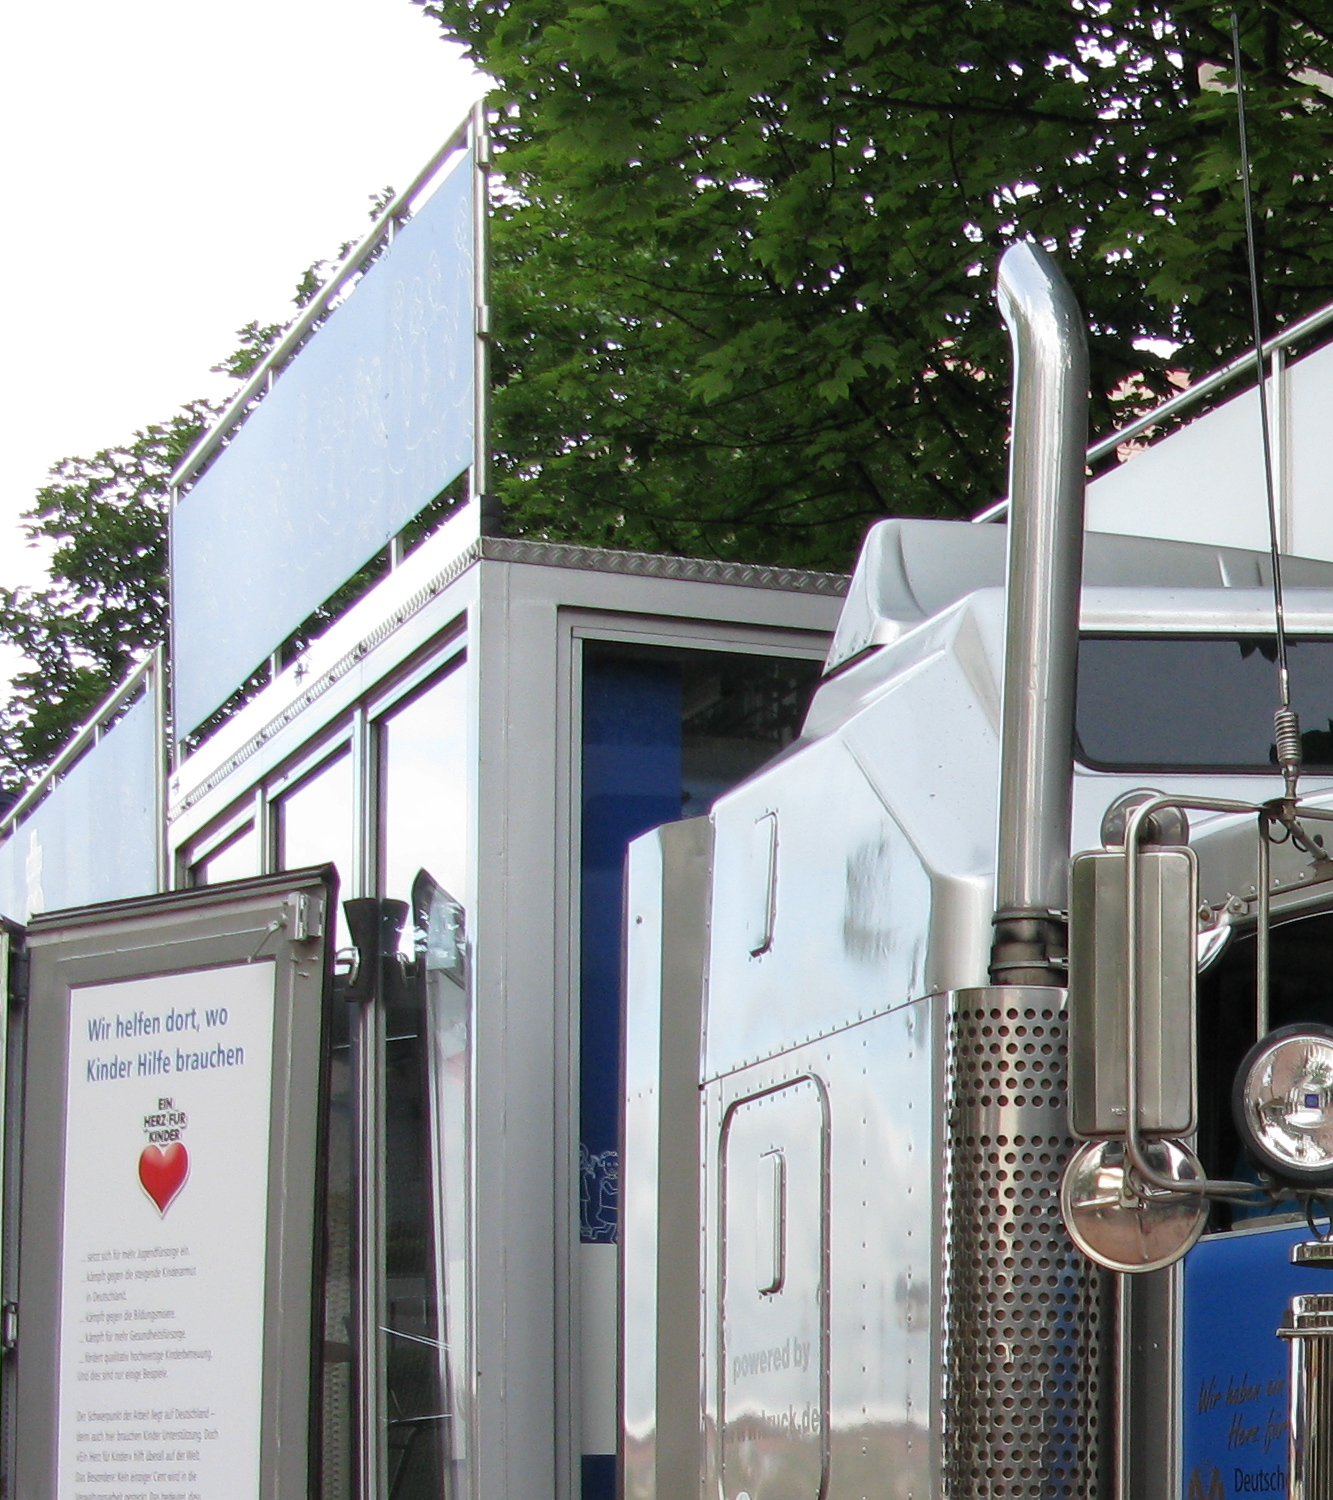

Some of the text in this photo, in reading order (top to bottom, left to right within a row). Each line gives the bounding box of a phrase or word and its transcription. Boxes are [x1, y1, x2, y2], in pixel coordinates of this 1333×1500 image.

[88, 1007, 228, 1042] Wir helfen dort, wo
[87, 1042, 244, 1082] Kinder Hilfe brauchen
[158, 1098, 172, 1111] EIN
[144, 1114, 166, 1128] HERZ
[149, 1129, 180, 1143] KINDER
[733, 1336, 811, 1386] powered by
[1198, 1374, 1221, 1415] Wir
[1226, 1373, 1260, 1405] haben
[1234, 1464, 1285, 1493] Deutsch
